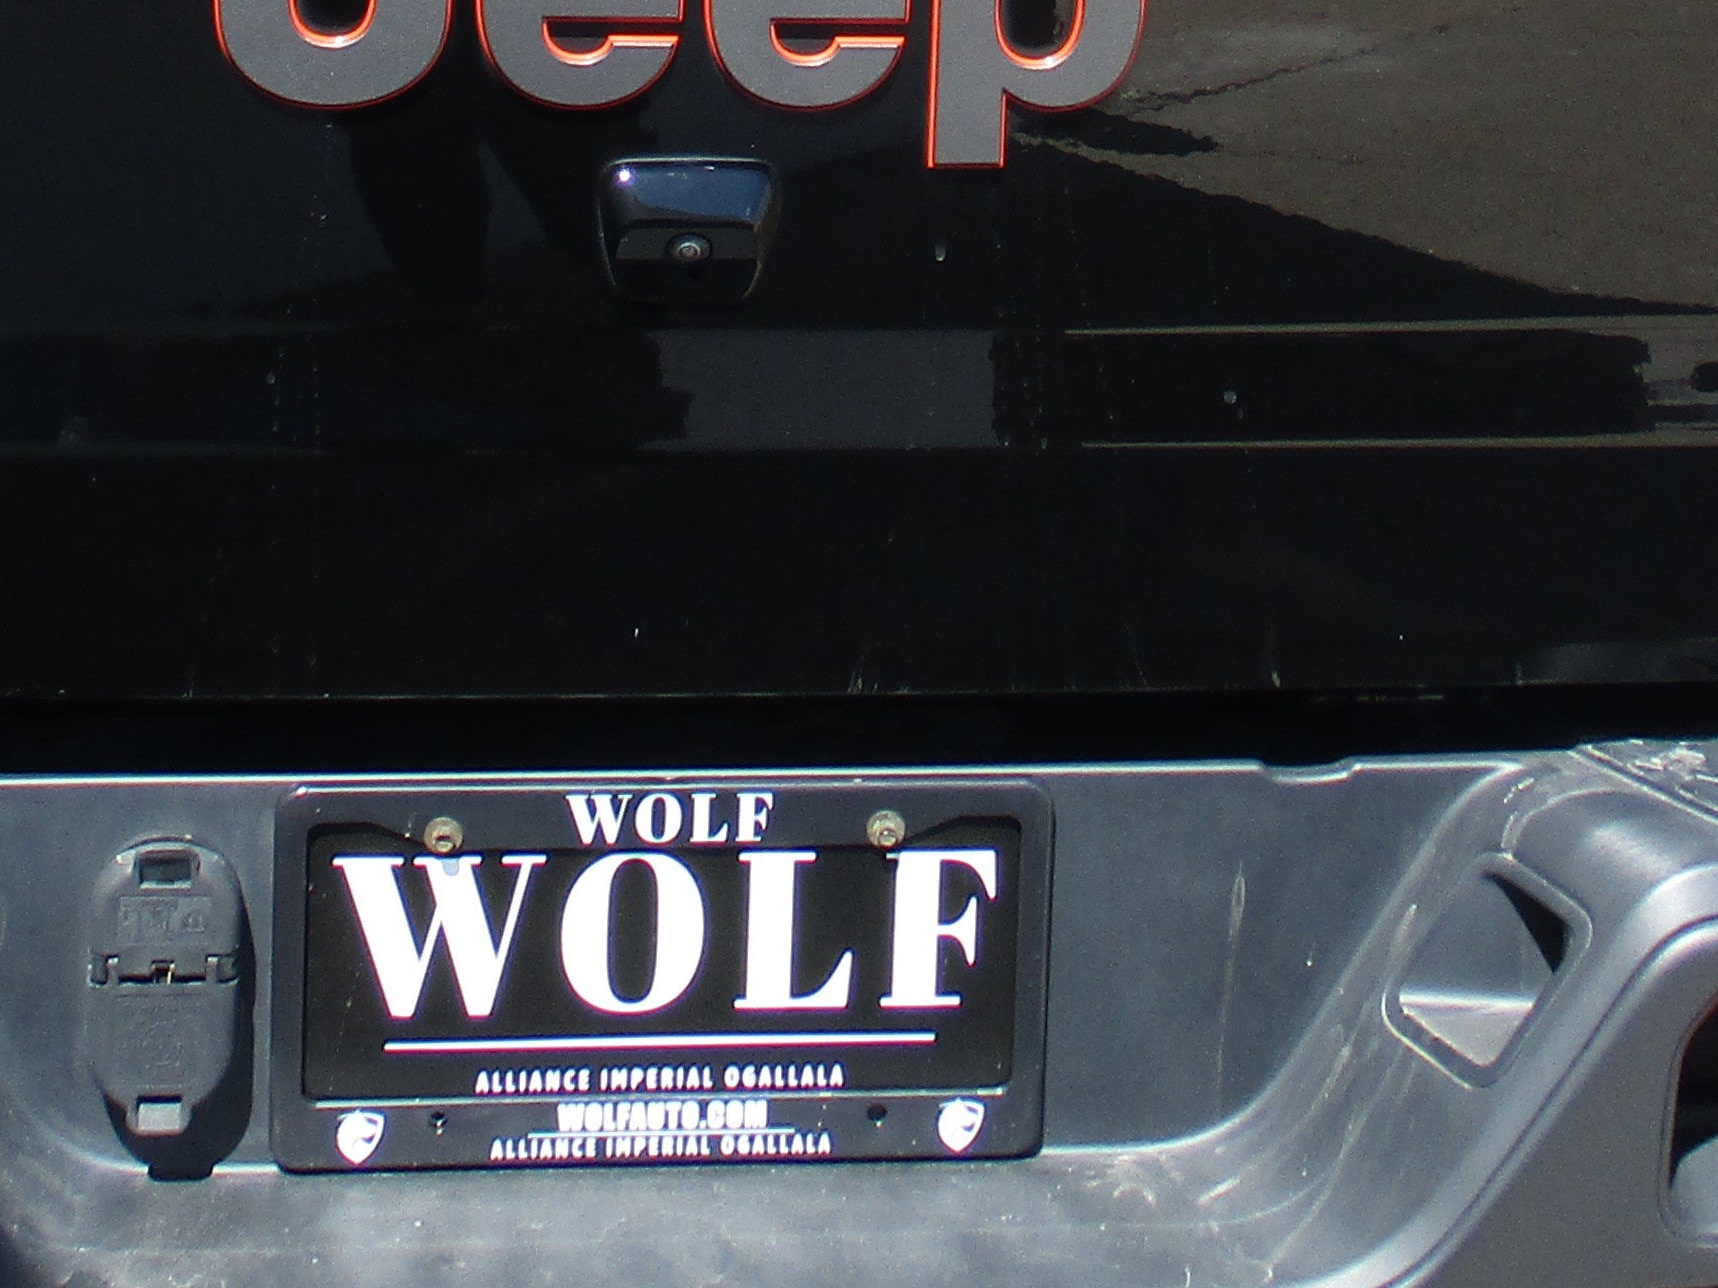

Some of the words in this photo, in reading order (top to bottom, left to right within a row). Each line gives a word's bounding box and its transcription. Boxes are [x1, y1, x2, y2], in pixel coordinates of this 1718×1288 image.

[565, 792, 776, 846] WOLF
[333, 849, 997, 1019] WOLF
[475, 1069, 591, 1094] ALLIANCE
[600, 1066, 714, 1092] IMPERIAL
[724, 1063, 845, 1090] OGALLALA
[557, 1099, 769, 1132] WOLFAUTO.COM
[490, 1137, 598, 1161] ALLIANCE
[604, 1135, 712, 1159] IMPERIAL
[720, 1133, 832, 1157] OGALLALA
